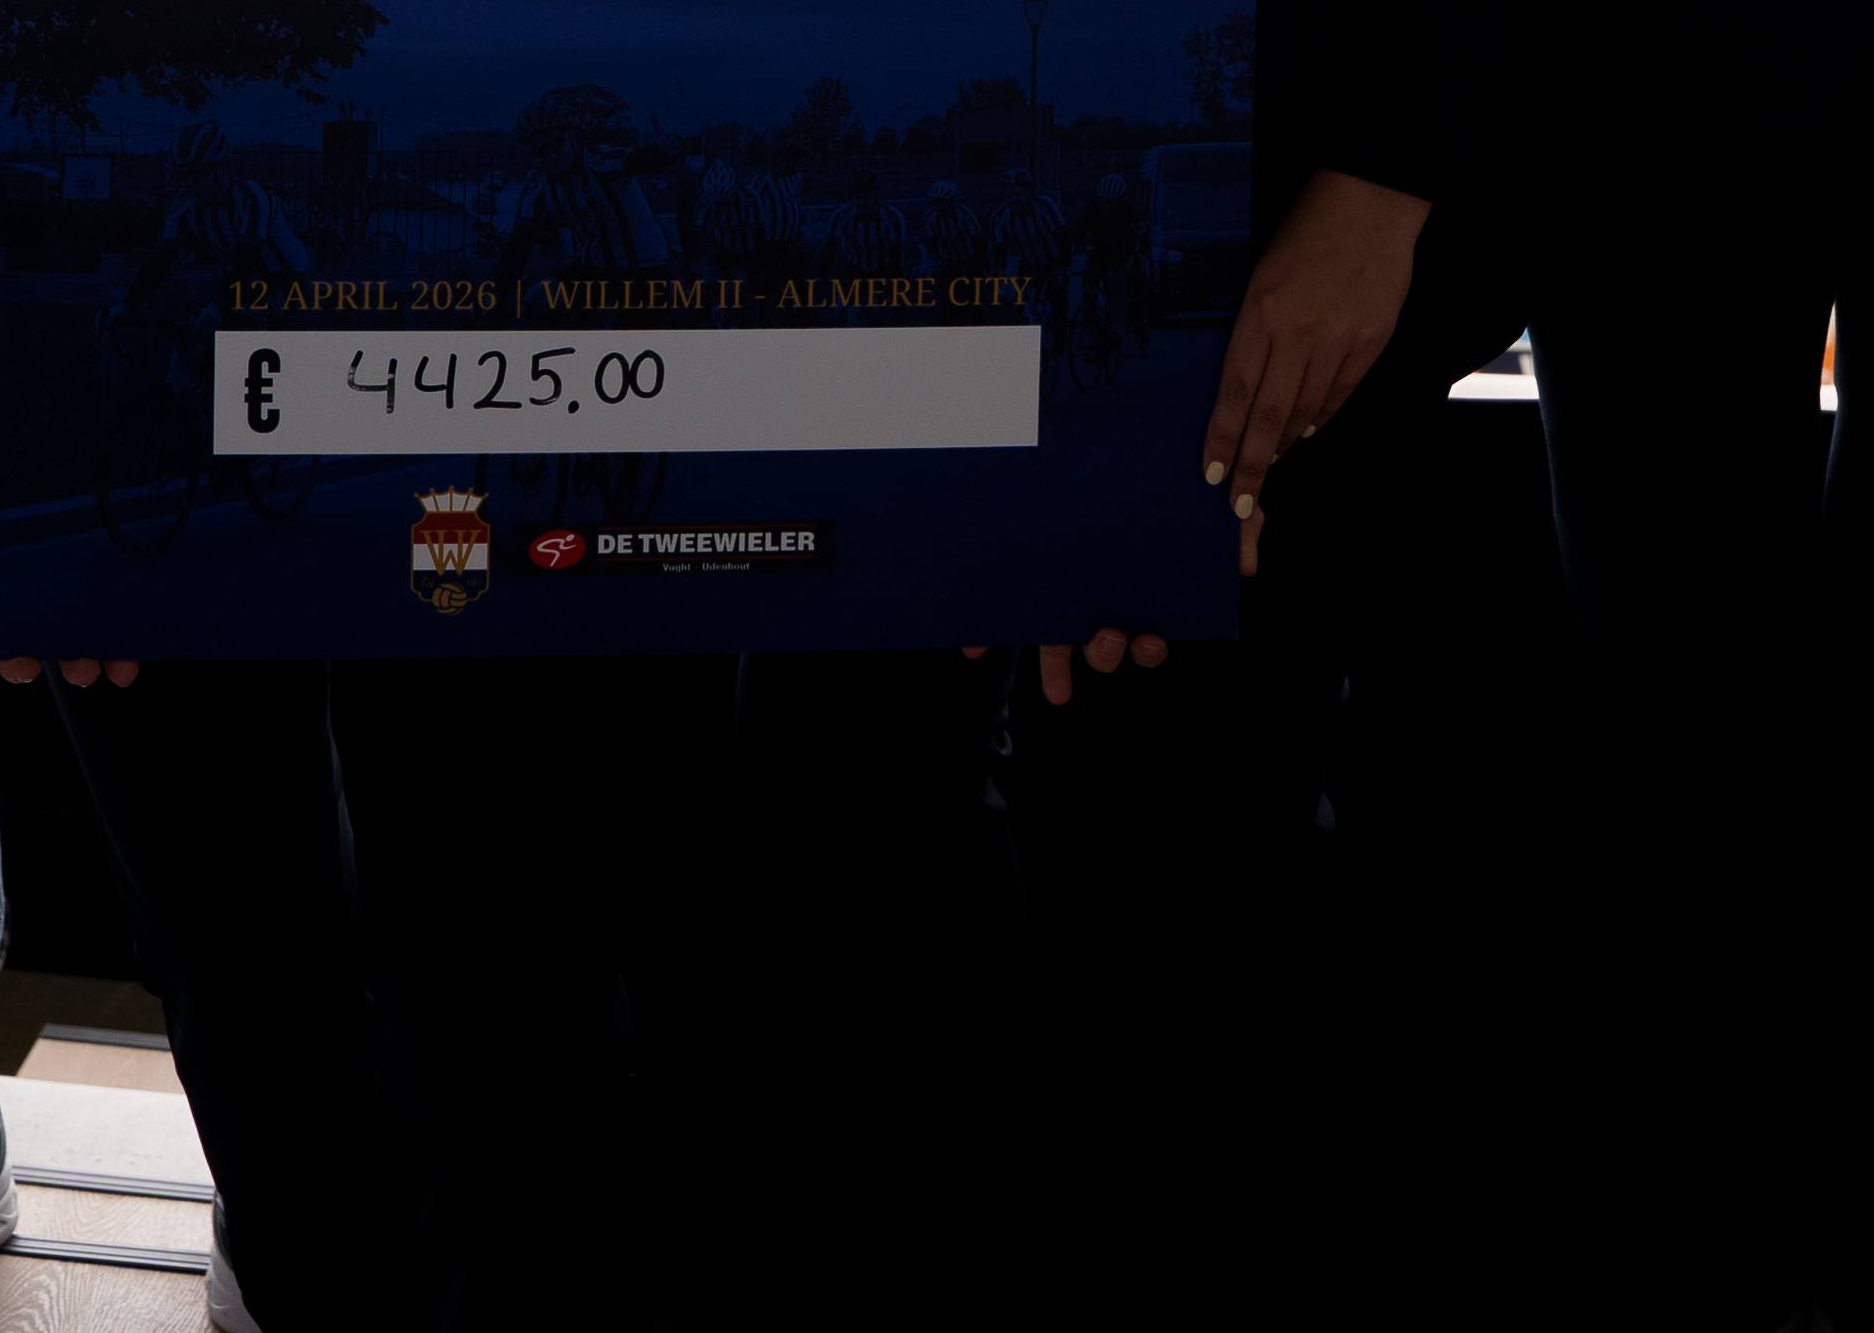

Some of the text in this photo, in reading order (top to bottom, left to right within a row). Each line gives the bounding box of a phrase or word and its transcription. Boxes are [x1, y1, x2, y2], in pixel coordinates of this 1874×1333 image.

[227, 281, 270, 311] 12
[280, 280, 399, 312] APRIL
[410, 280, 498, 311] 2026
[541, 278, 705, 311] WILLEM
[718, 278, 744, 309] II
[776, 276, 937, 309] ALMERE
[948, 276, 1033, 307] CITY
[244, 345, 665, 433] € 4425.00
[597, 531, 815, 554] DE TWEEWIELER
[662, 563, 691, 573] Vught
[701, 562, 750, 571] Udenhout
